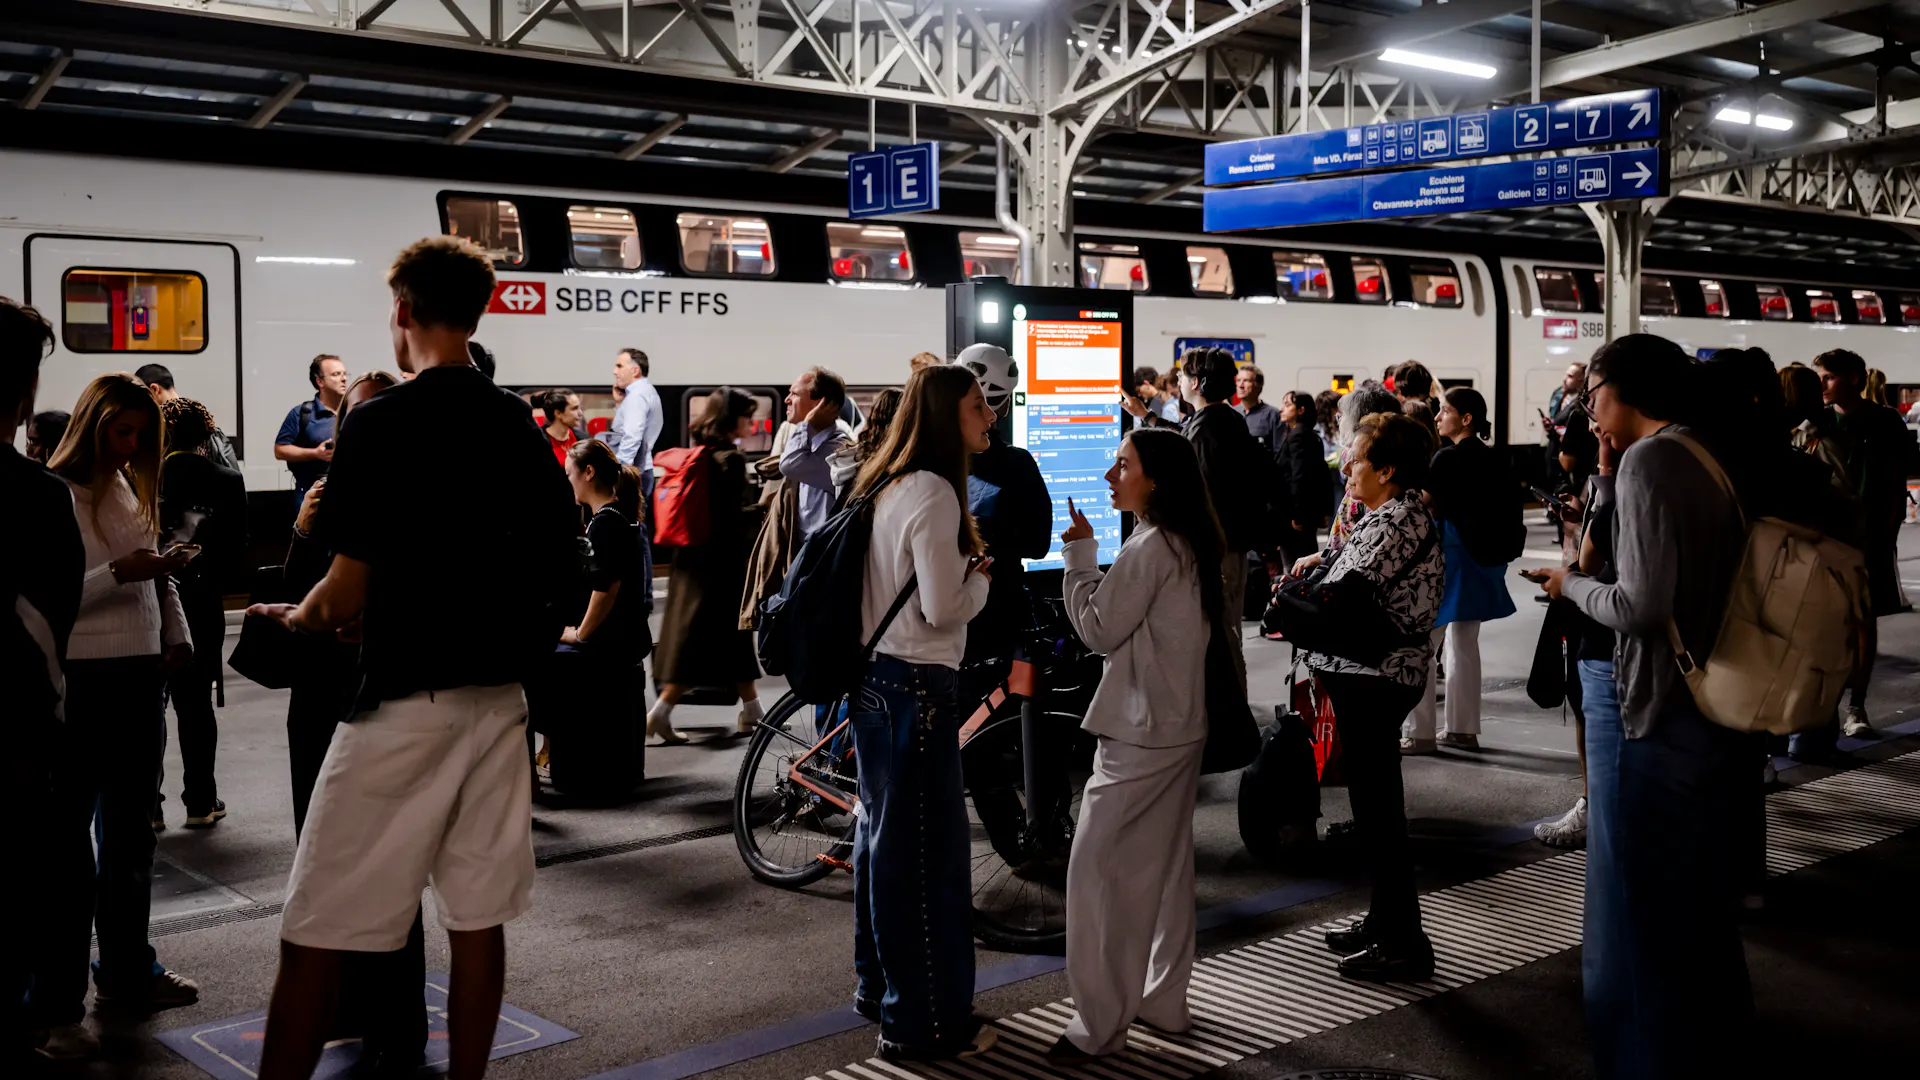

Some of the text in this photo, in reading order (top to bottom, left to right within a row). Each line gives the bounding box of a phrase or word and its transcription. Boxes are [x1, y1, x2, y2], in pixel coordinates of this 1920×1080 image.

[1404, 126, 1413, 136] 17
[1524, 118, 1539, 143] 2
[1586, 110, 1600, 135] 7
[1367, 150, 1377, 160] 32
[1404, 146, 1413, 156] 19
[1229, 162, 1275, 175] Renens centre
[1536, 164, 1568, 176] 33 25
[862, 166, 918, 204] 1 E
[1429, 175, 1464, 186] Ecublens
[1420, 184, 1464, 197] Renens sud
[1498, 185, 1567, 200] Galicien 32 31
[1373, 195, 1465, 211] Chavannes-près-Renens
[556, 287, 729, 315] SBB CFF FFS
[1582, 321, 1604, 337] SBB
